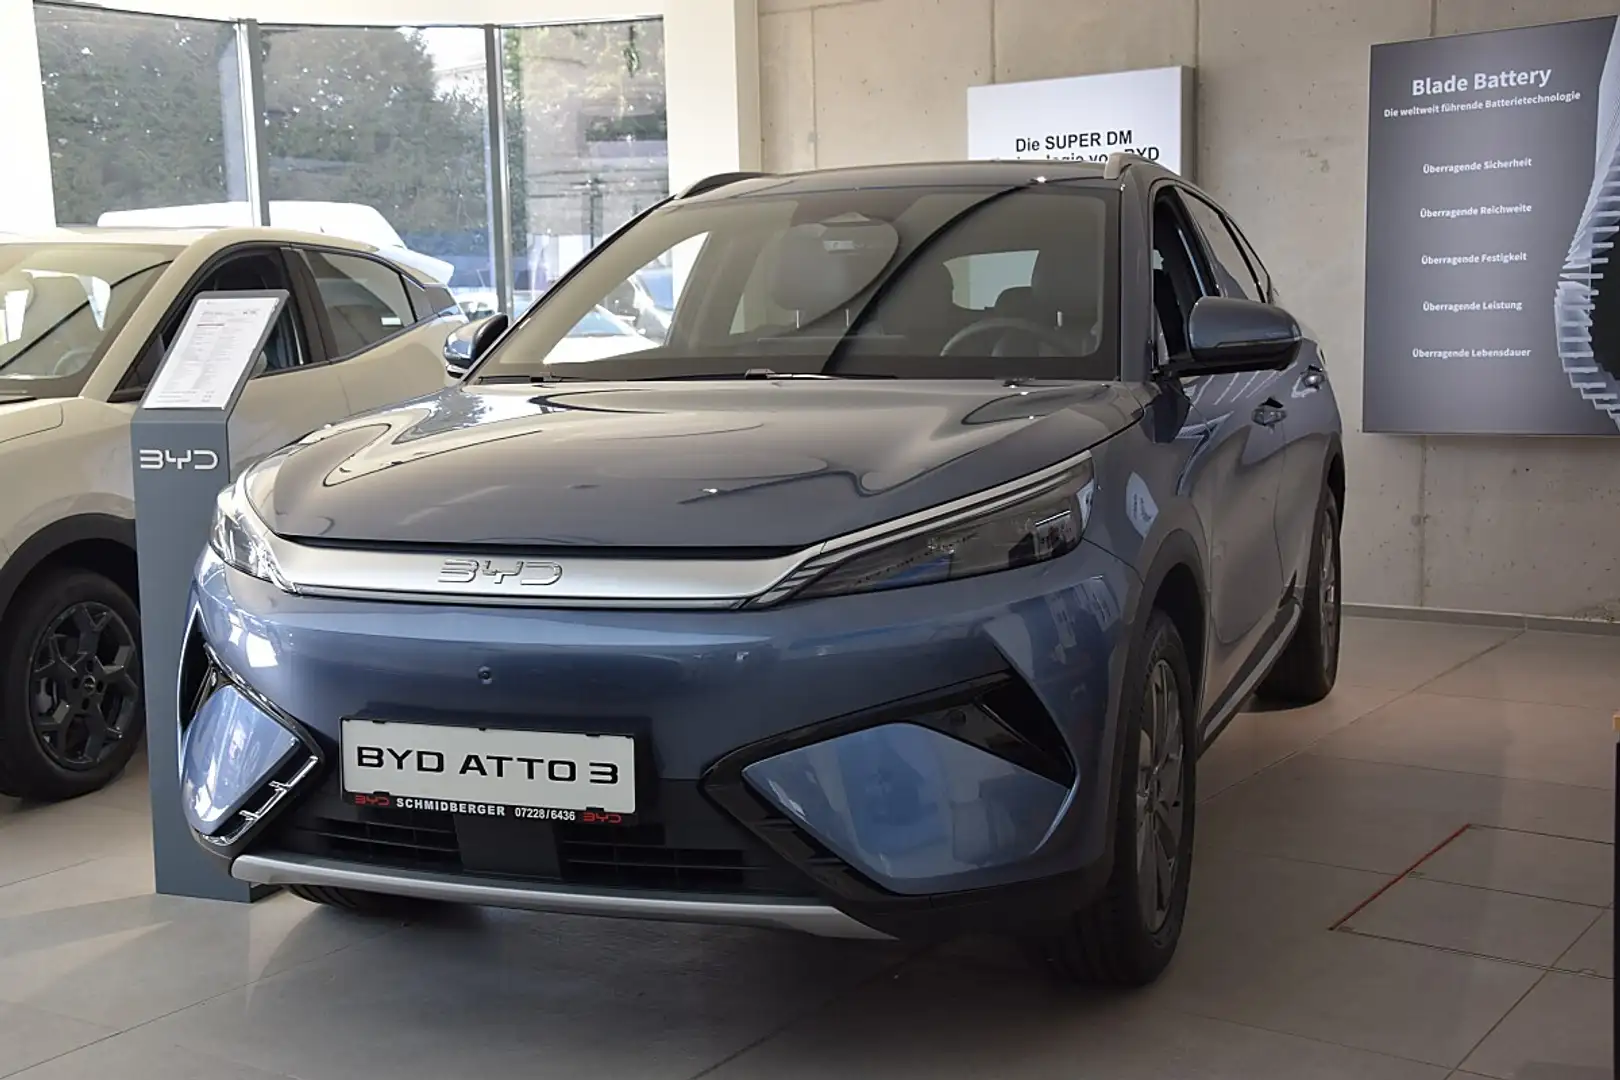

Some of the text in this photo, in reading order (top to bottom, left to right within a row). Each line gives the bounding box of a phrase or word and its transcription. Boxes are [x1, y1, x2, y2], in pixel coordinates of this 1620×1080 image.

[1412, 68, 1552, 96] Blade Battery
[1384, 91, 1581, 118] Die weltweit führende Batterietechnologie
[1015, 130, 1133, 152] Die SUPER DM
[1422, 157, 1532, 174] Überragende Sicherheit
[1420, 203, 1532, 218] Überragende Reichweite
[1421, 252, 1527, 265] Überragende Festigkeit
[1422, 301, 1523, 313] Überragende Leistung
[1412, 347, 1531, 359] Überragende Lebensdauer
[139, 449, 219, 470] BYD
[438, 559, 563, 586] BYD
[357, 746, 619, 785] BYD ATTO 3
[355, 794, 622, 824] BYD SCHMIDBERGER 07228/6436 BYD
